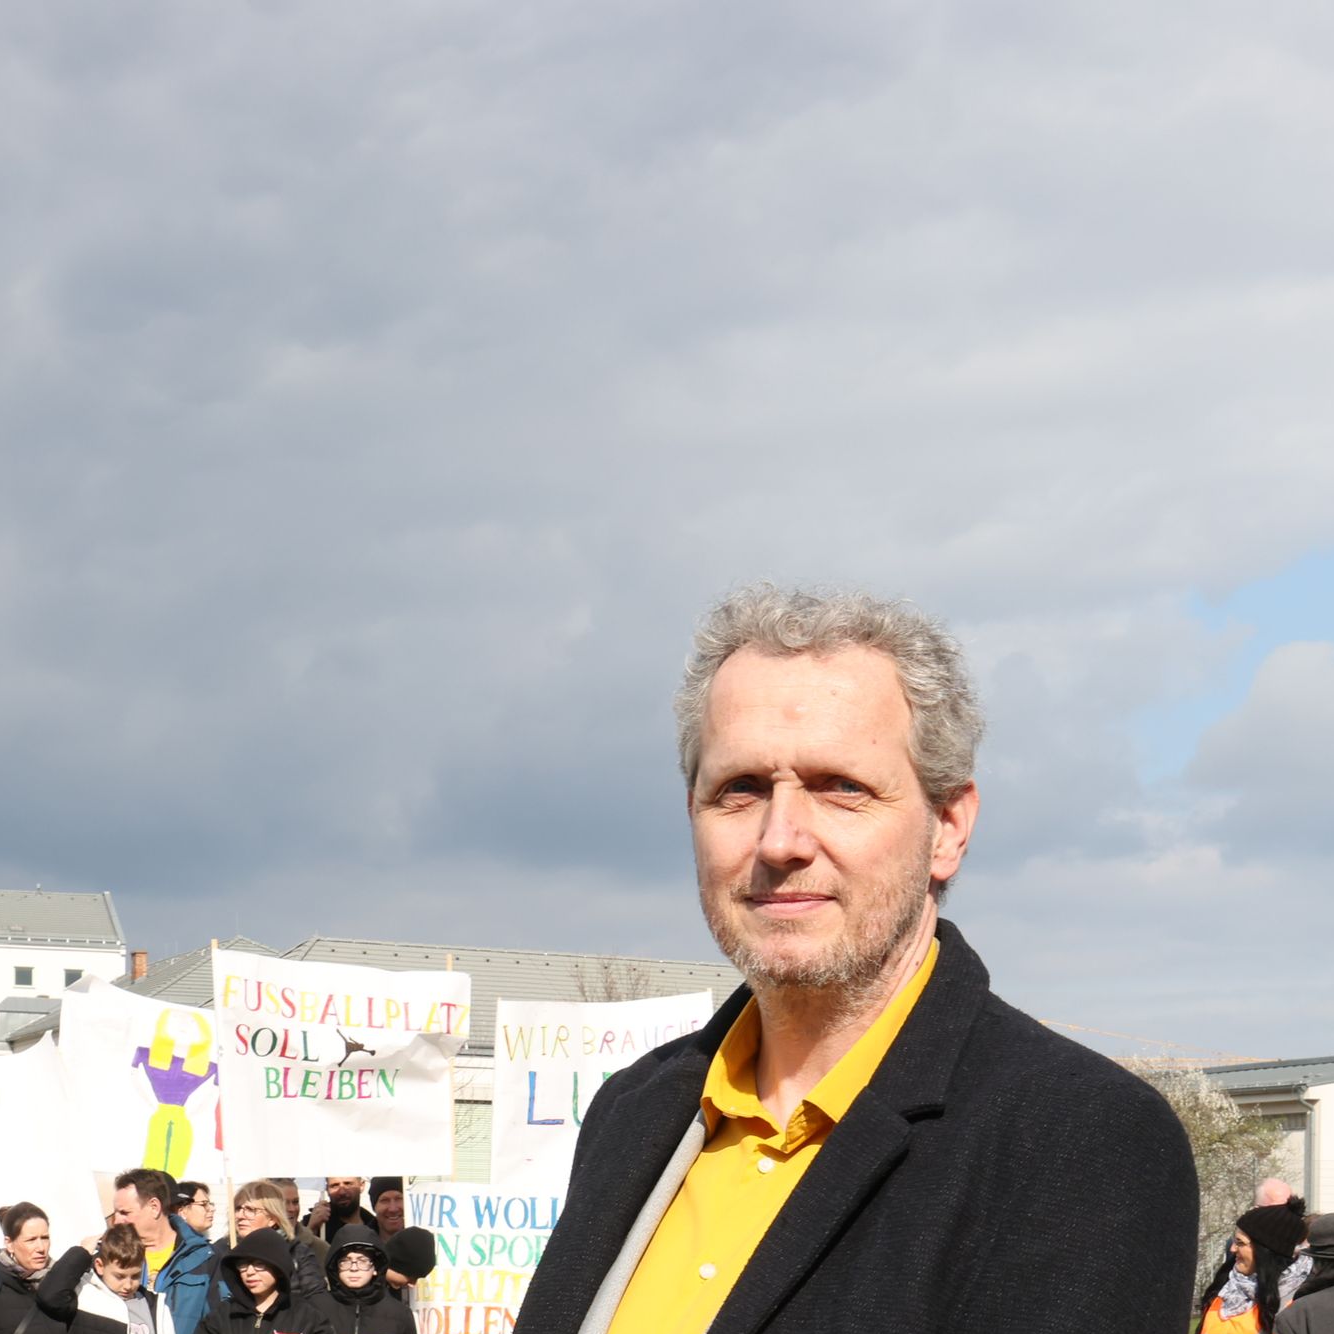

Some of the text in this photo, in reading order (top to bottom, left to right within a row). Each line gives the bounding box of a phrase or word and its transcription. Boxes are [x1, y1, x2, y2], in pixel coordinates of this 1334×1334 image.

[221, 974, 469, 1039] FUSSBALLPLATZ
[235, 1023, 320, 1065] SOLL
[503, 1025, 571, 1063] WIR
[264, 1065, 401, 1102] BLEIBEN
[409, 1193, 459, 1228] WIR
